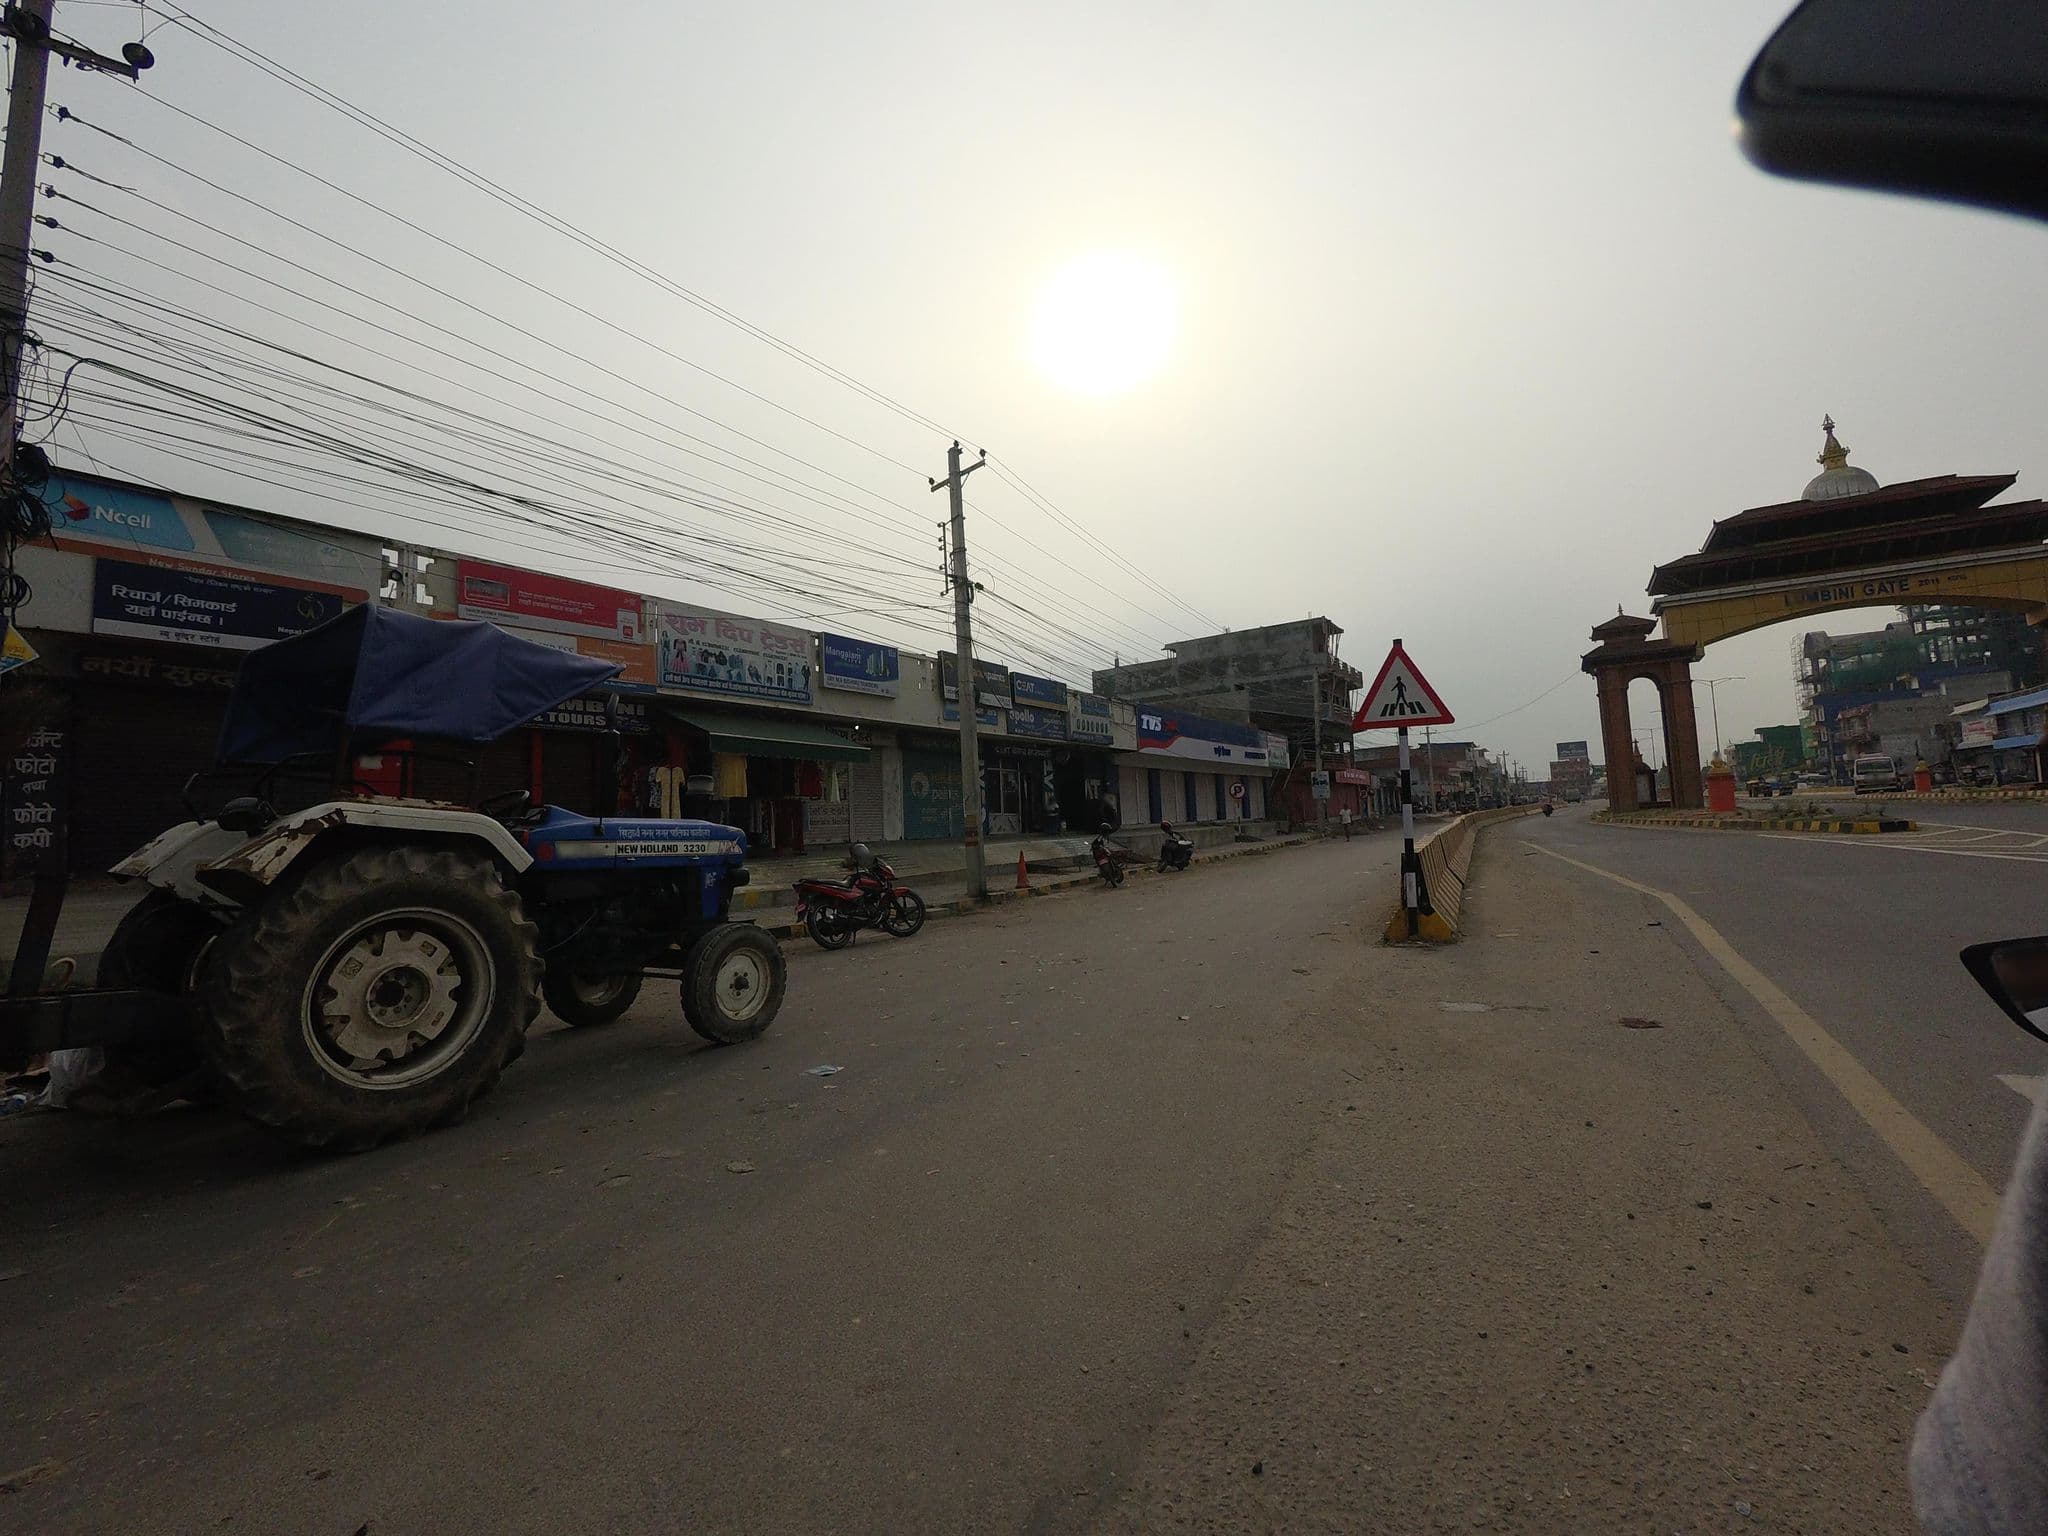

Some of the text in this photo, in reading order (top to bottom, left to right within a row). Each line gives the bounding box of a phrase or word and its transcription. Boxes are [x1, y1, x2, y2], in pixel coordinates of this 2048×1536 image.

[96, 505, 151, 528] Ncell
[149, 558, 174, 569] New
[178, 562, 217, 576] Sundar
[1863, 578, 1910, 598] GATE
[161, 662, 239, 690] सुन्द
[1016, 679, 1036, 694] CEAT
[547, 711, 607, 726] TOURS
[1009, 708, 1035, 725] apollo
[1141, 714, 1162, 732] TVS
[14, 753, 56, 775] फोटो
[22, 779, 48, 793] तथा
[13, 802, 56, 824] फोटो
[617, 844, 706, 854] NEW HOLLAND 3230
